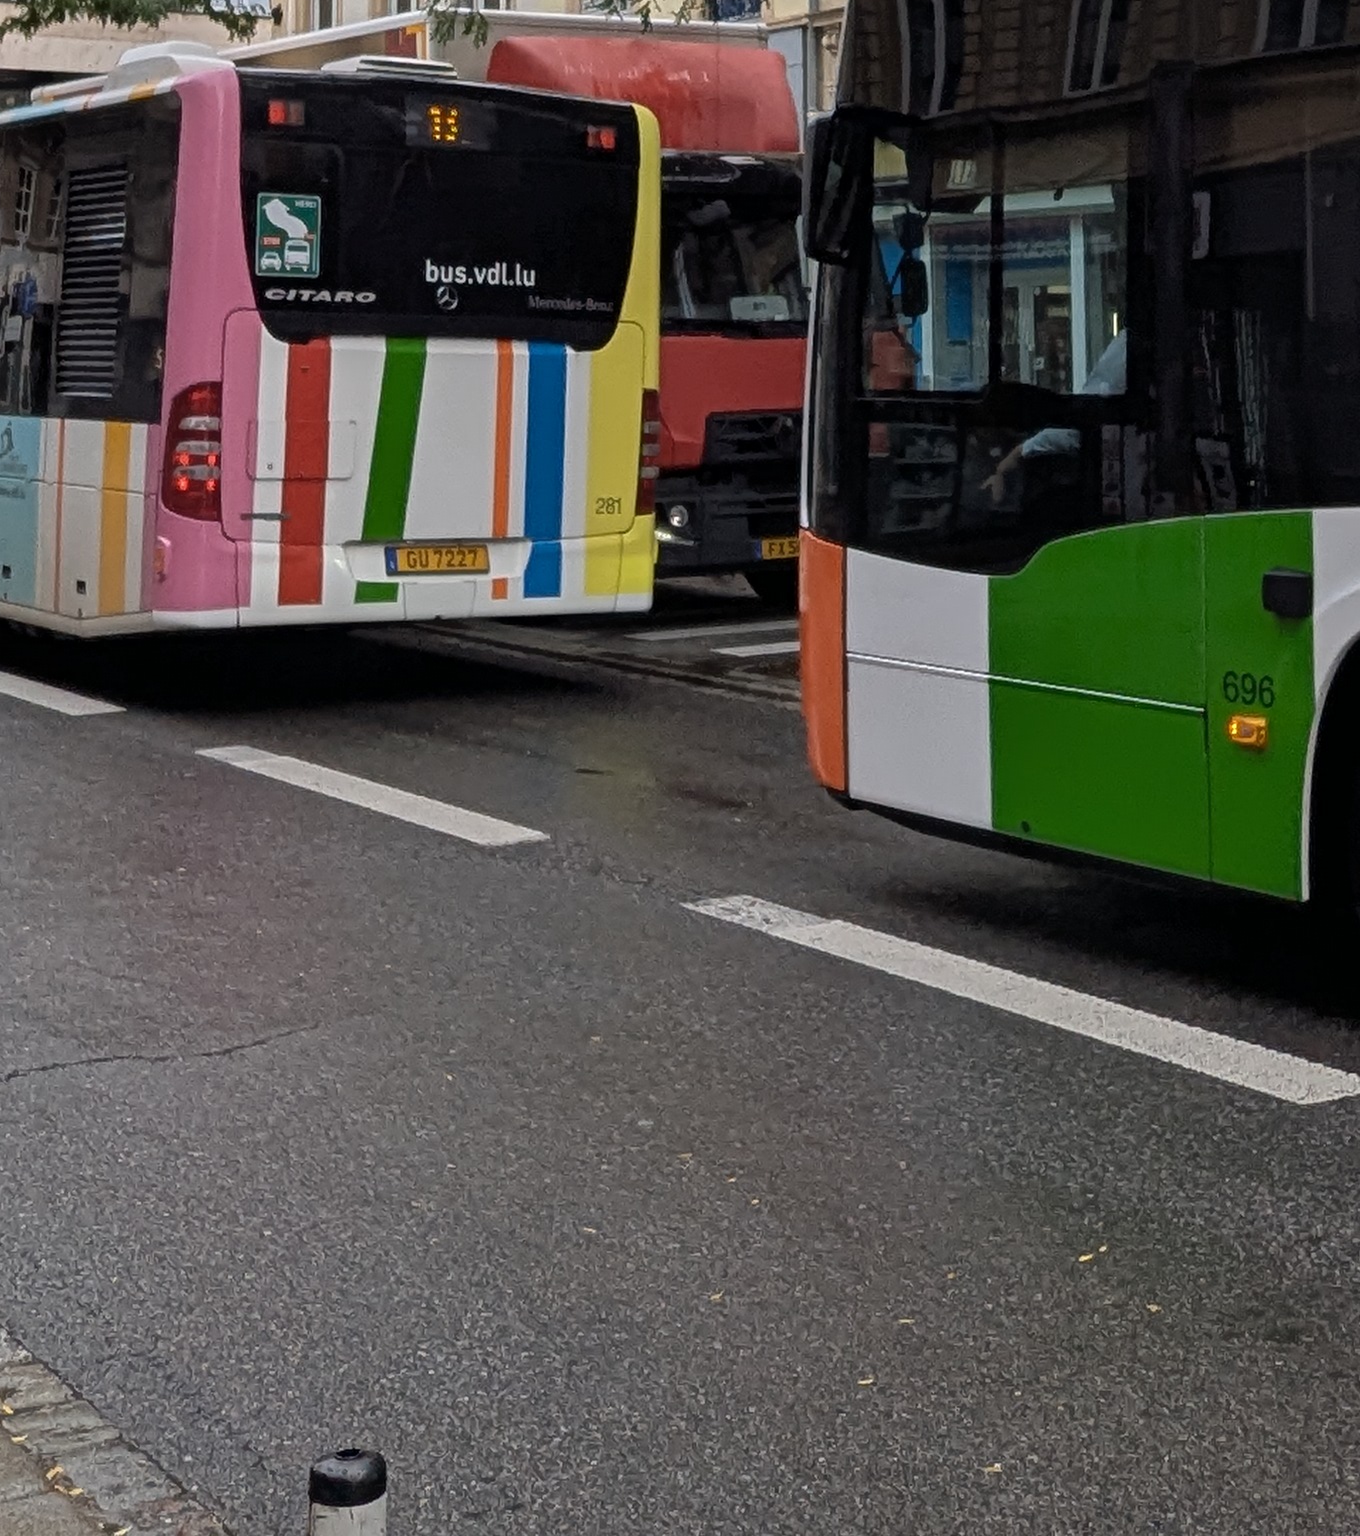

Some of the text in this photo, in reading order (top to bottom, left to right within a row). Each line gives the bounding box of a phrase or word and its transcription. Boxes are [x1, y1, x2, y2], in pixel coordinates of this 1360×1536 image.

[424, 258, 536, 287] bus.vdl.lu
[265, 288, 377, 303] CITARO
[595, 497, 623, 515] 281
[406, 548, 478, 569] GU 7227
[1222, 671, 1275, 708] 696
